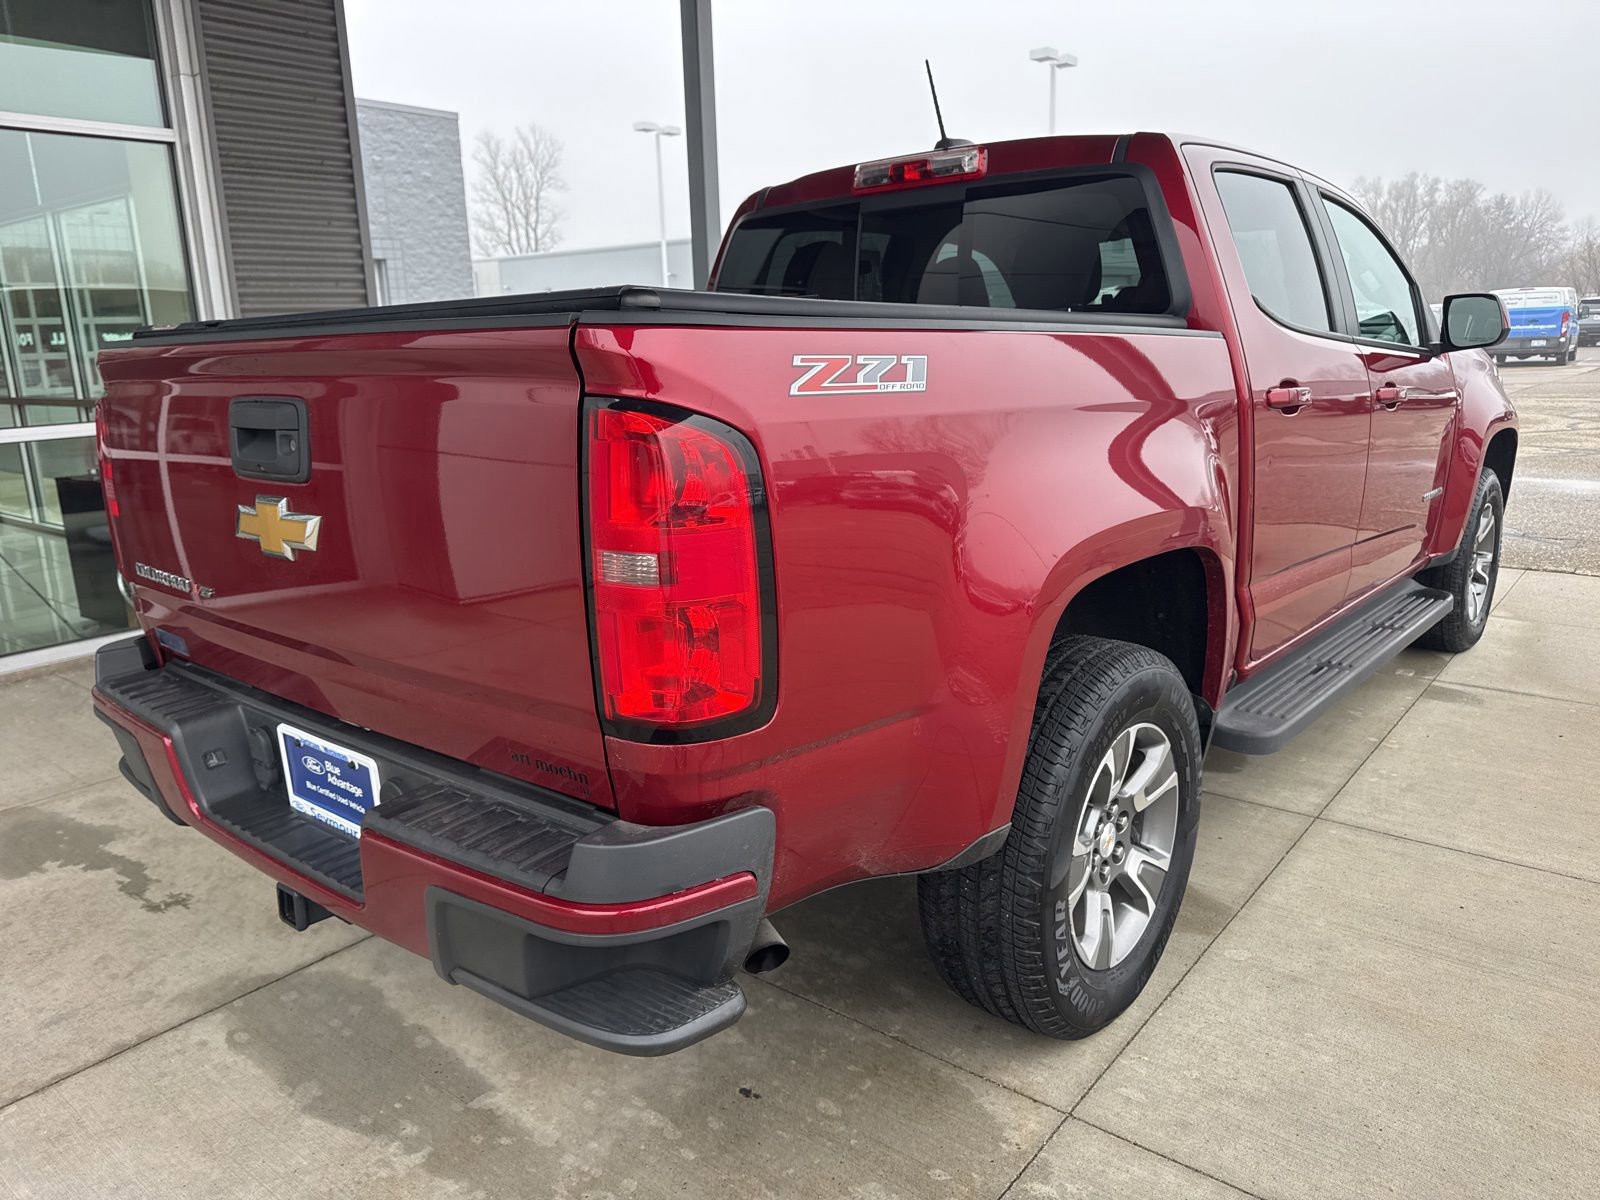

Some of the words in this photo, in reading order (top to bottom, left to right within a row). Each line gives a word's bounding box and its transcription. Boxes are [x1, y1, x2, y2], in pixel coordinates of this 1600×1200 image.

[789, 354, 928, 396] Z71
[879, 383, 898, 391] OFF
[900, 382, 926, 390] ROAD
[324, 760, 341, 776] Blue
[305, 780, 317, 791] Blue
[328, 773, 364, 798] Advantage
